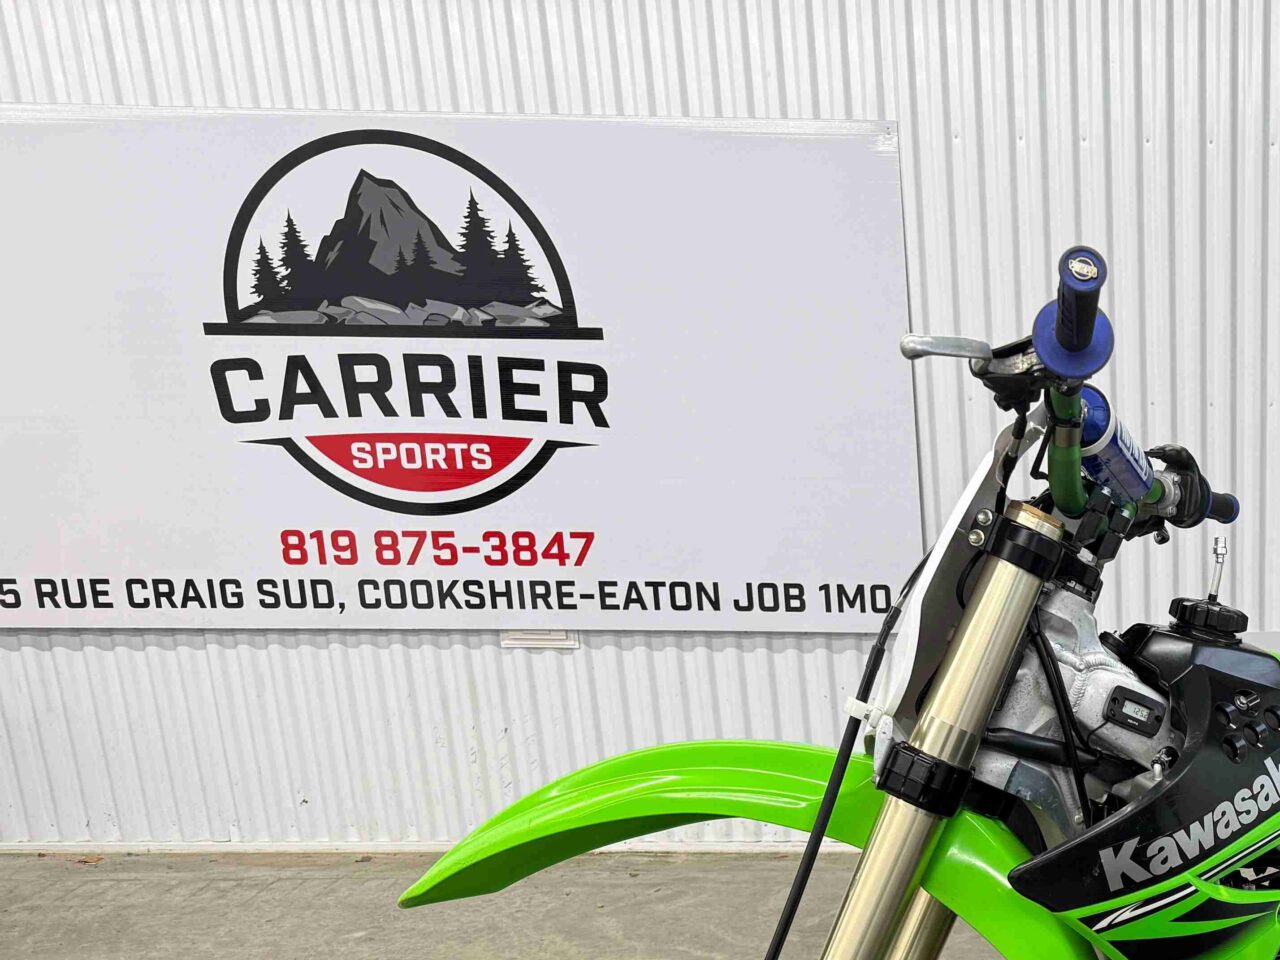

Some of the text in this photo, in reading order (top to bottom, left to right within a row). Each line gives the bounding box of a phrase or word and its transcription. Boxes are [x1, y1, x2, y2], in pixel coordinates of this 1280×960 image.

[209, 352, 610, 429] CARRIER
[351, 440, 493, 472] SPORTS
[280, 529, 595, 566] 819 875-3847
[34, 578, 114, 609] RUE
[125, 578, 244, 609] CRAIG
[257, 578, 346, 614] SUD,
[358, 579, 721, 611] COOKSHIRE-EATON
